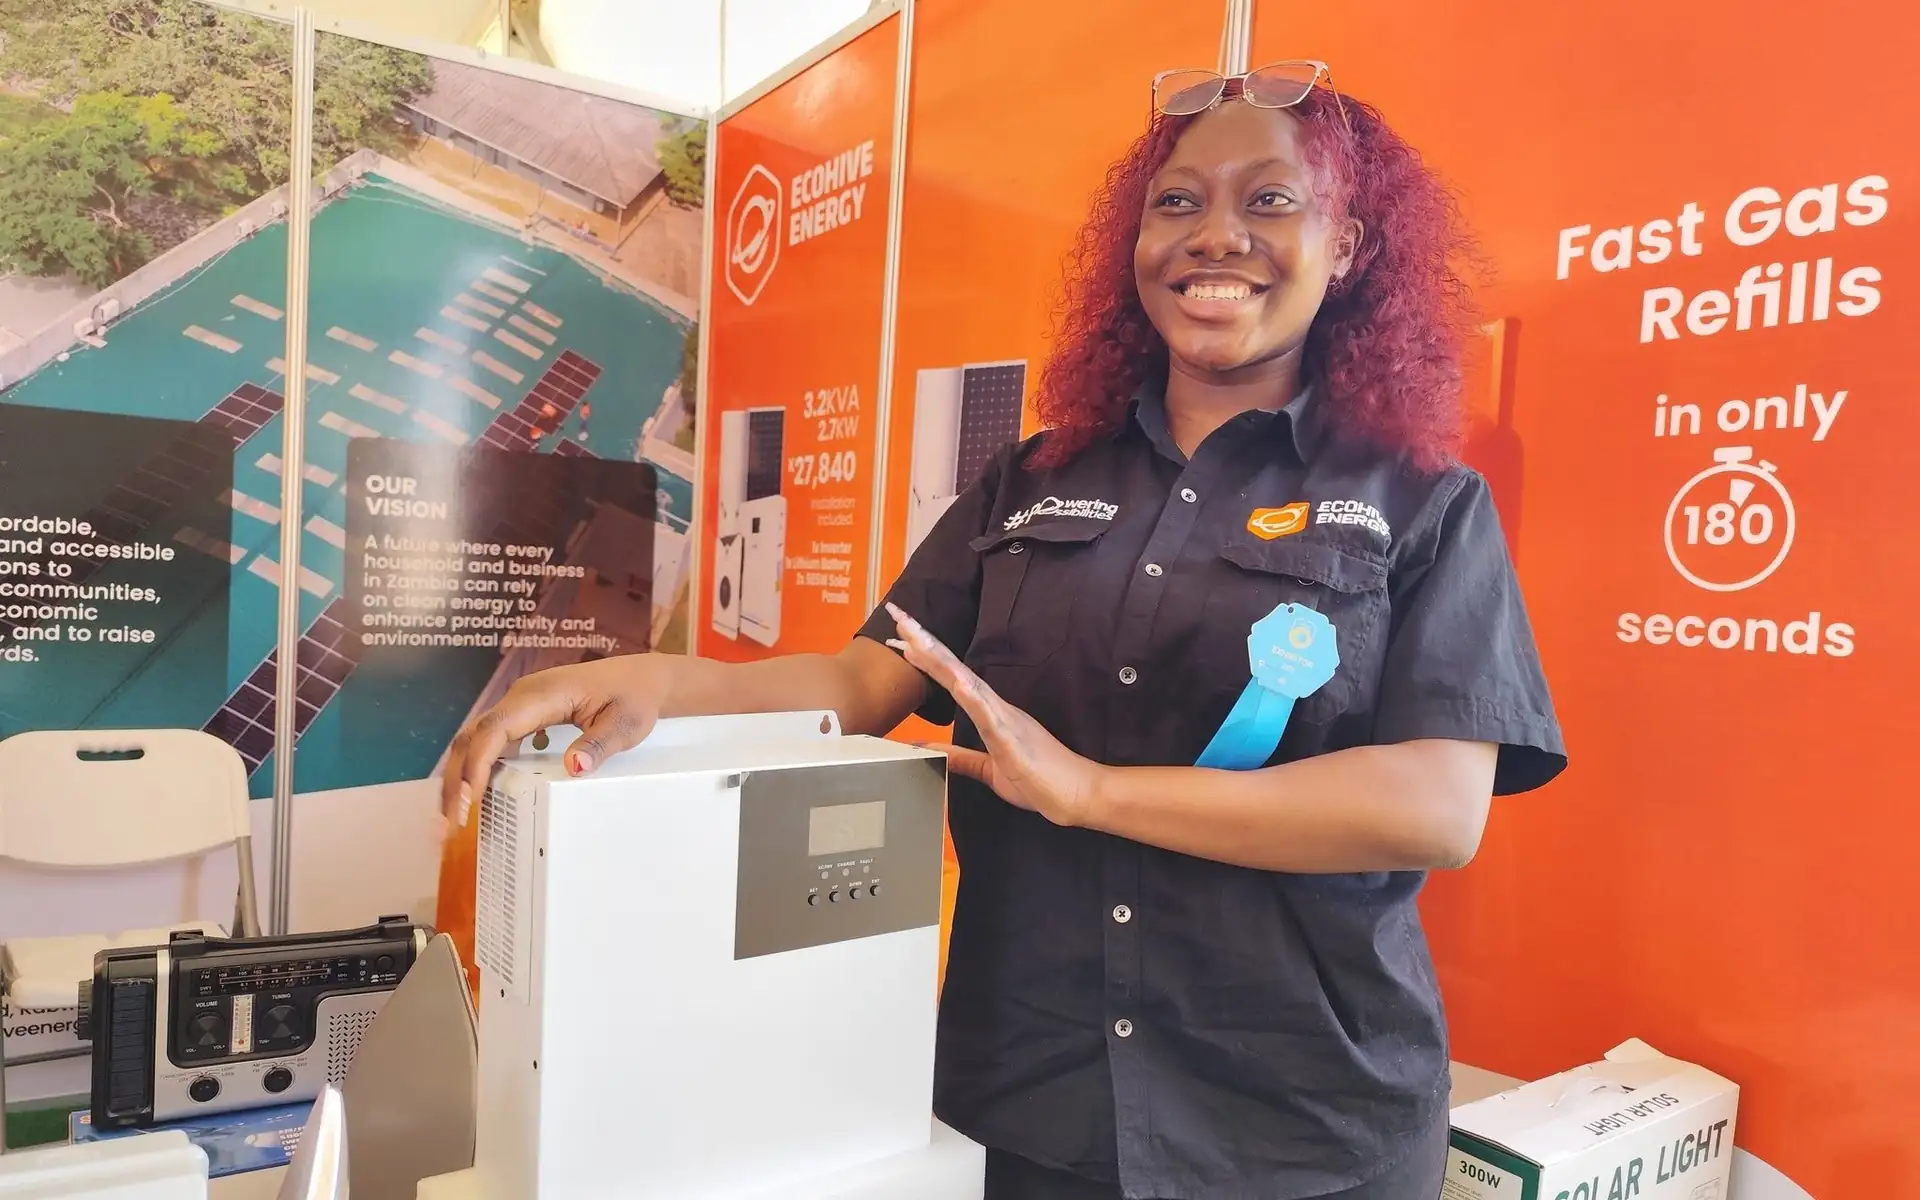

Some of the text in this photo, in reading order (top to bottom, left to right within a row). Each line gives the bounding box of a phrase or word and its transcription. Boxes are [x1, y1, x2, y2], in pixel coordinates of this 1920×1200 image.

[790, 140, 874, 210] ECOHIVE
[789, 182, 866, 247] ENERGY
[1556, 174, 1889, 281] Fast Gas
[1640, 256, 1883, 344] Refills
[803, 385, 860, 419] 3.2KVA
[1654, 383, 1849, 442] in only
[366, 475, 417, 495] OUR
[365, 497, 448, 520] VISION
[1684, 503, 1774, 546] 180
[50, 542, 175, 561] accessible
[365, 534, 554, 562] A future where every
[48, 560, 72, 577] to
[364, 553, 585, 578] household and business
[0, 583, 161, 604] communities,
[364, 572, 537, 598] in Zambia can rely
[363, 594, 537, 615] on clean energy to
[12, 624, 61, 641] and
[68, 625, 92, 641] to
[99, 625, 156, 643] raise
[362, 612, 595, 634] enhance productivity and
[1616, 611, 1855, 657] seconds
[361, 629, 620, 652] environmental sustainability.
[195, 1000, 218, 1008] VOLUME
[272, 992, 291, 1000] TUNING
[1583, 1093, 1680, 1136] SOLAR LIGHT
[1554, 1119, 1728, 1200] LAR LIGHT
[1459, 1160, 1501, 1189] 300W
